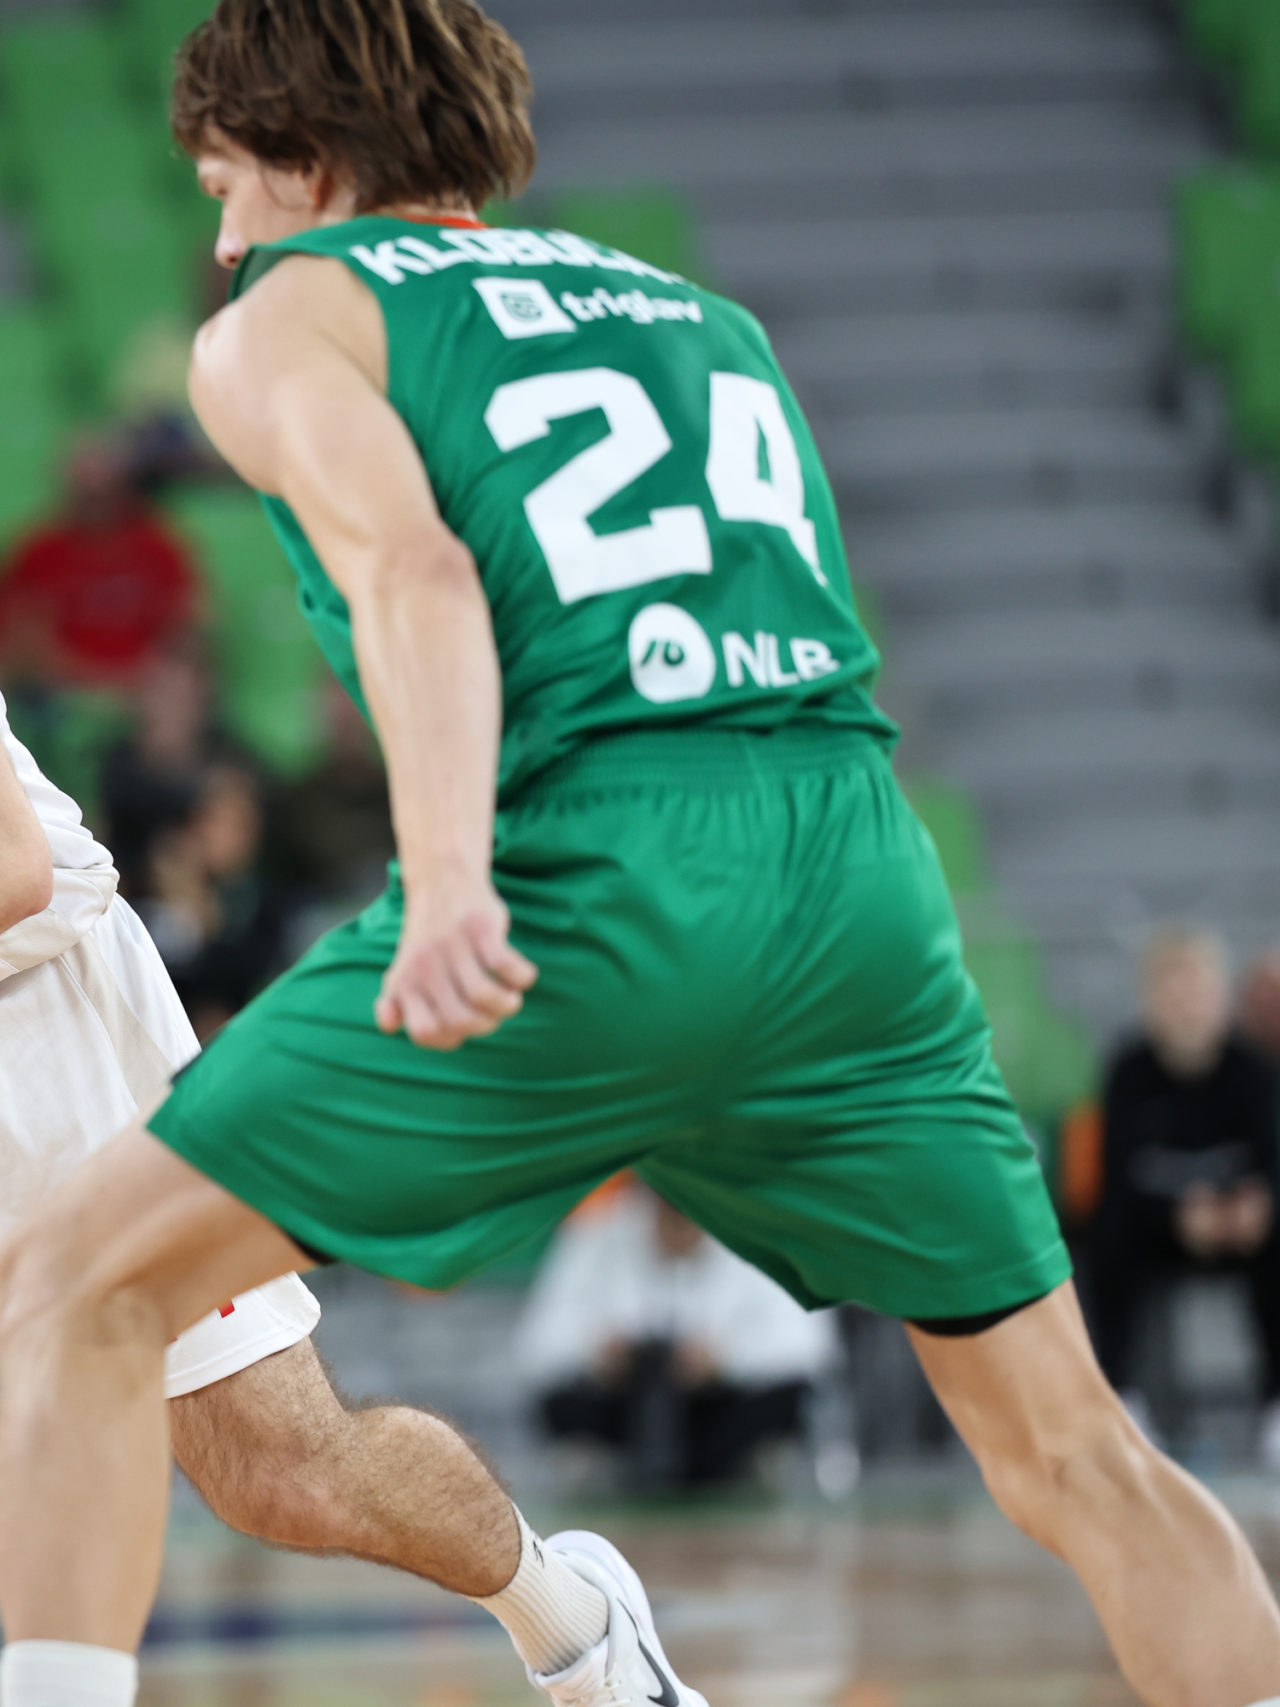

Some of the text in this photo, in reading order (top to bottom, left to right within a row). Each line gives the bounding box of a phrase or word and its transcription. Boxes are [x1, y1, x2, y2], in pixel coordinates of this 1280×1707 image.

[350, 228, 696, 285] KLOBU
[561, 287, 703, 324] triglav
[484, 367, 827, 606] 24
